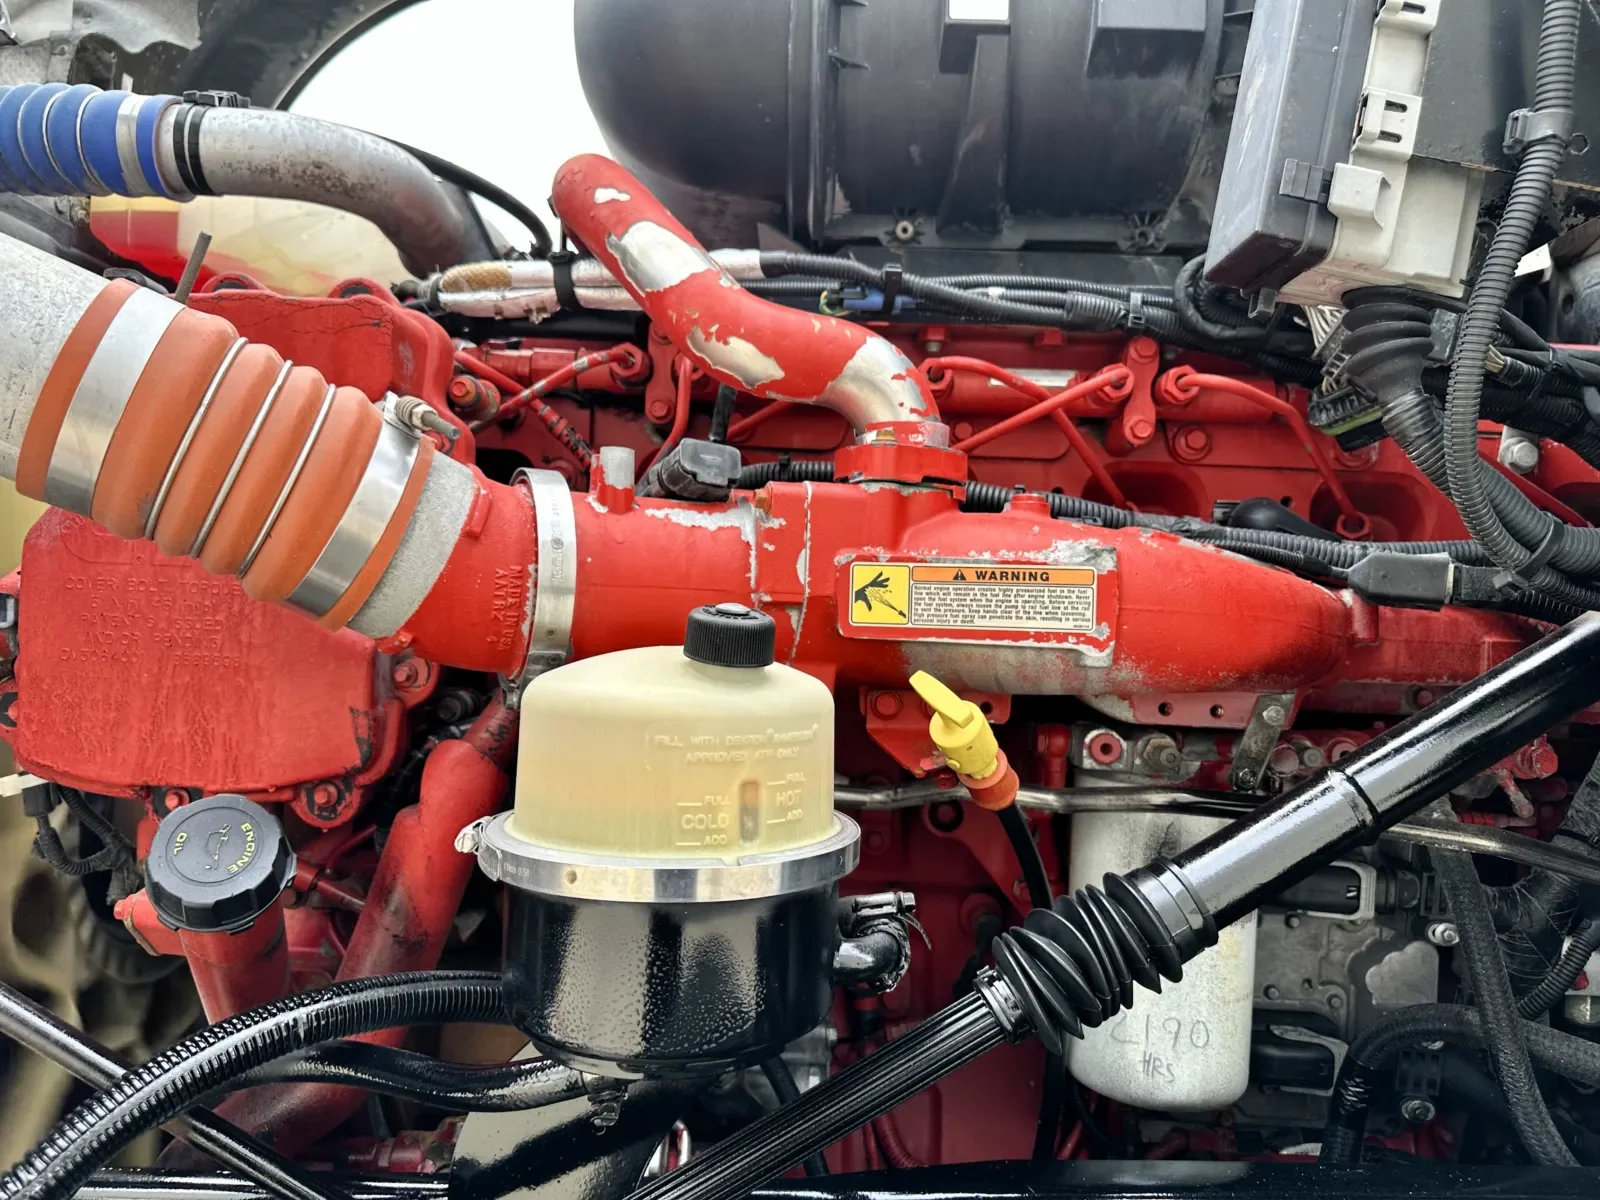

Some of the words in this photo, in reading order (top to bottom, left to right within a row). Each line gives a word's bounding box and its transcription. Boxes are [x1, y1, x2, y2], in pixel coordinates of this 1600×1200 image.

[976, 570, 1050, 582] WARNING
[64, 576, 115, 591] COVER
[127, 576, 168, 593] BOLT
[179, 579, 242, 595] TORQUE
[508, 565, 523, 607] MADE
[504, 612, 520, 626] IN
[152, 632, 222, 650] PENDING
[654, 733, 683, 747] FILL
[691, 735, 720, 746] WITH
[684, 751, 748, 763] APPROVED
[777, 747, 800, 758] ONLY
[786, 773, 806, 782] FULL
[704, 796, 731, 806] FULL
[776, 790, 802, 806] HOT
[681, 814, 730, 829] COLD
[786, 809, 803, 821] ADD
[703, 835, 728, 845] ADD
[227, 822, 257, 875] ENGINE
[1110, 1007, 1210, 1051] 2190
[1139, 1050, 1175, 1084] HRS
